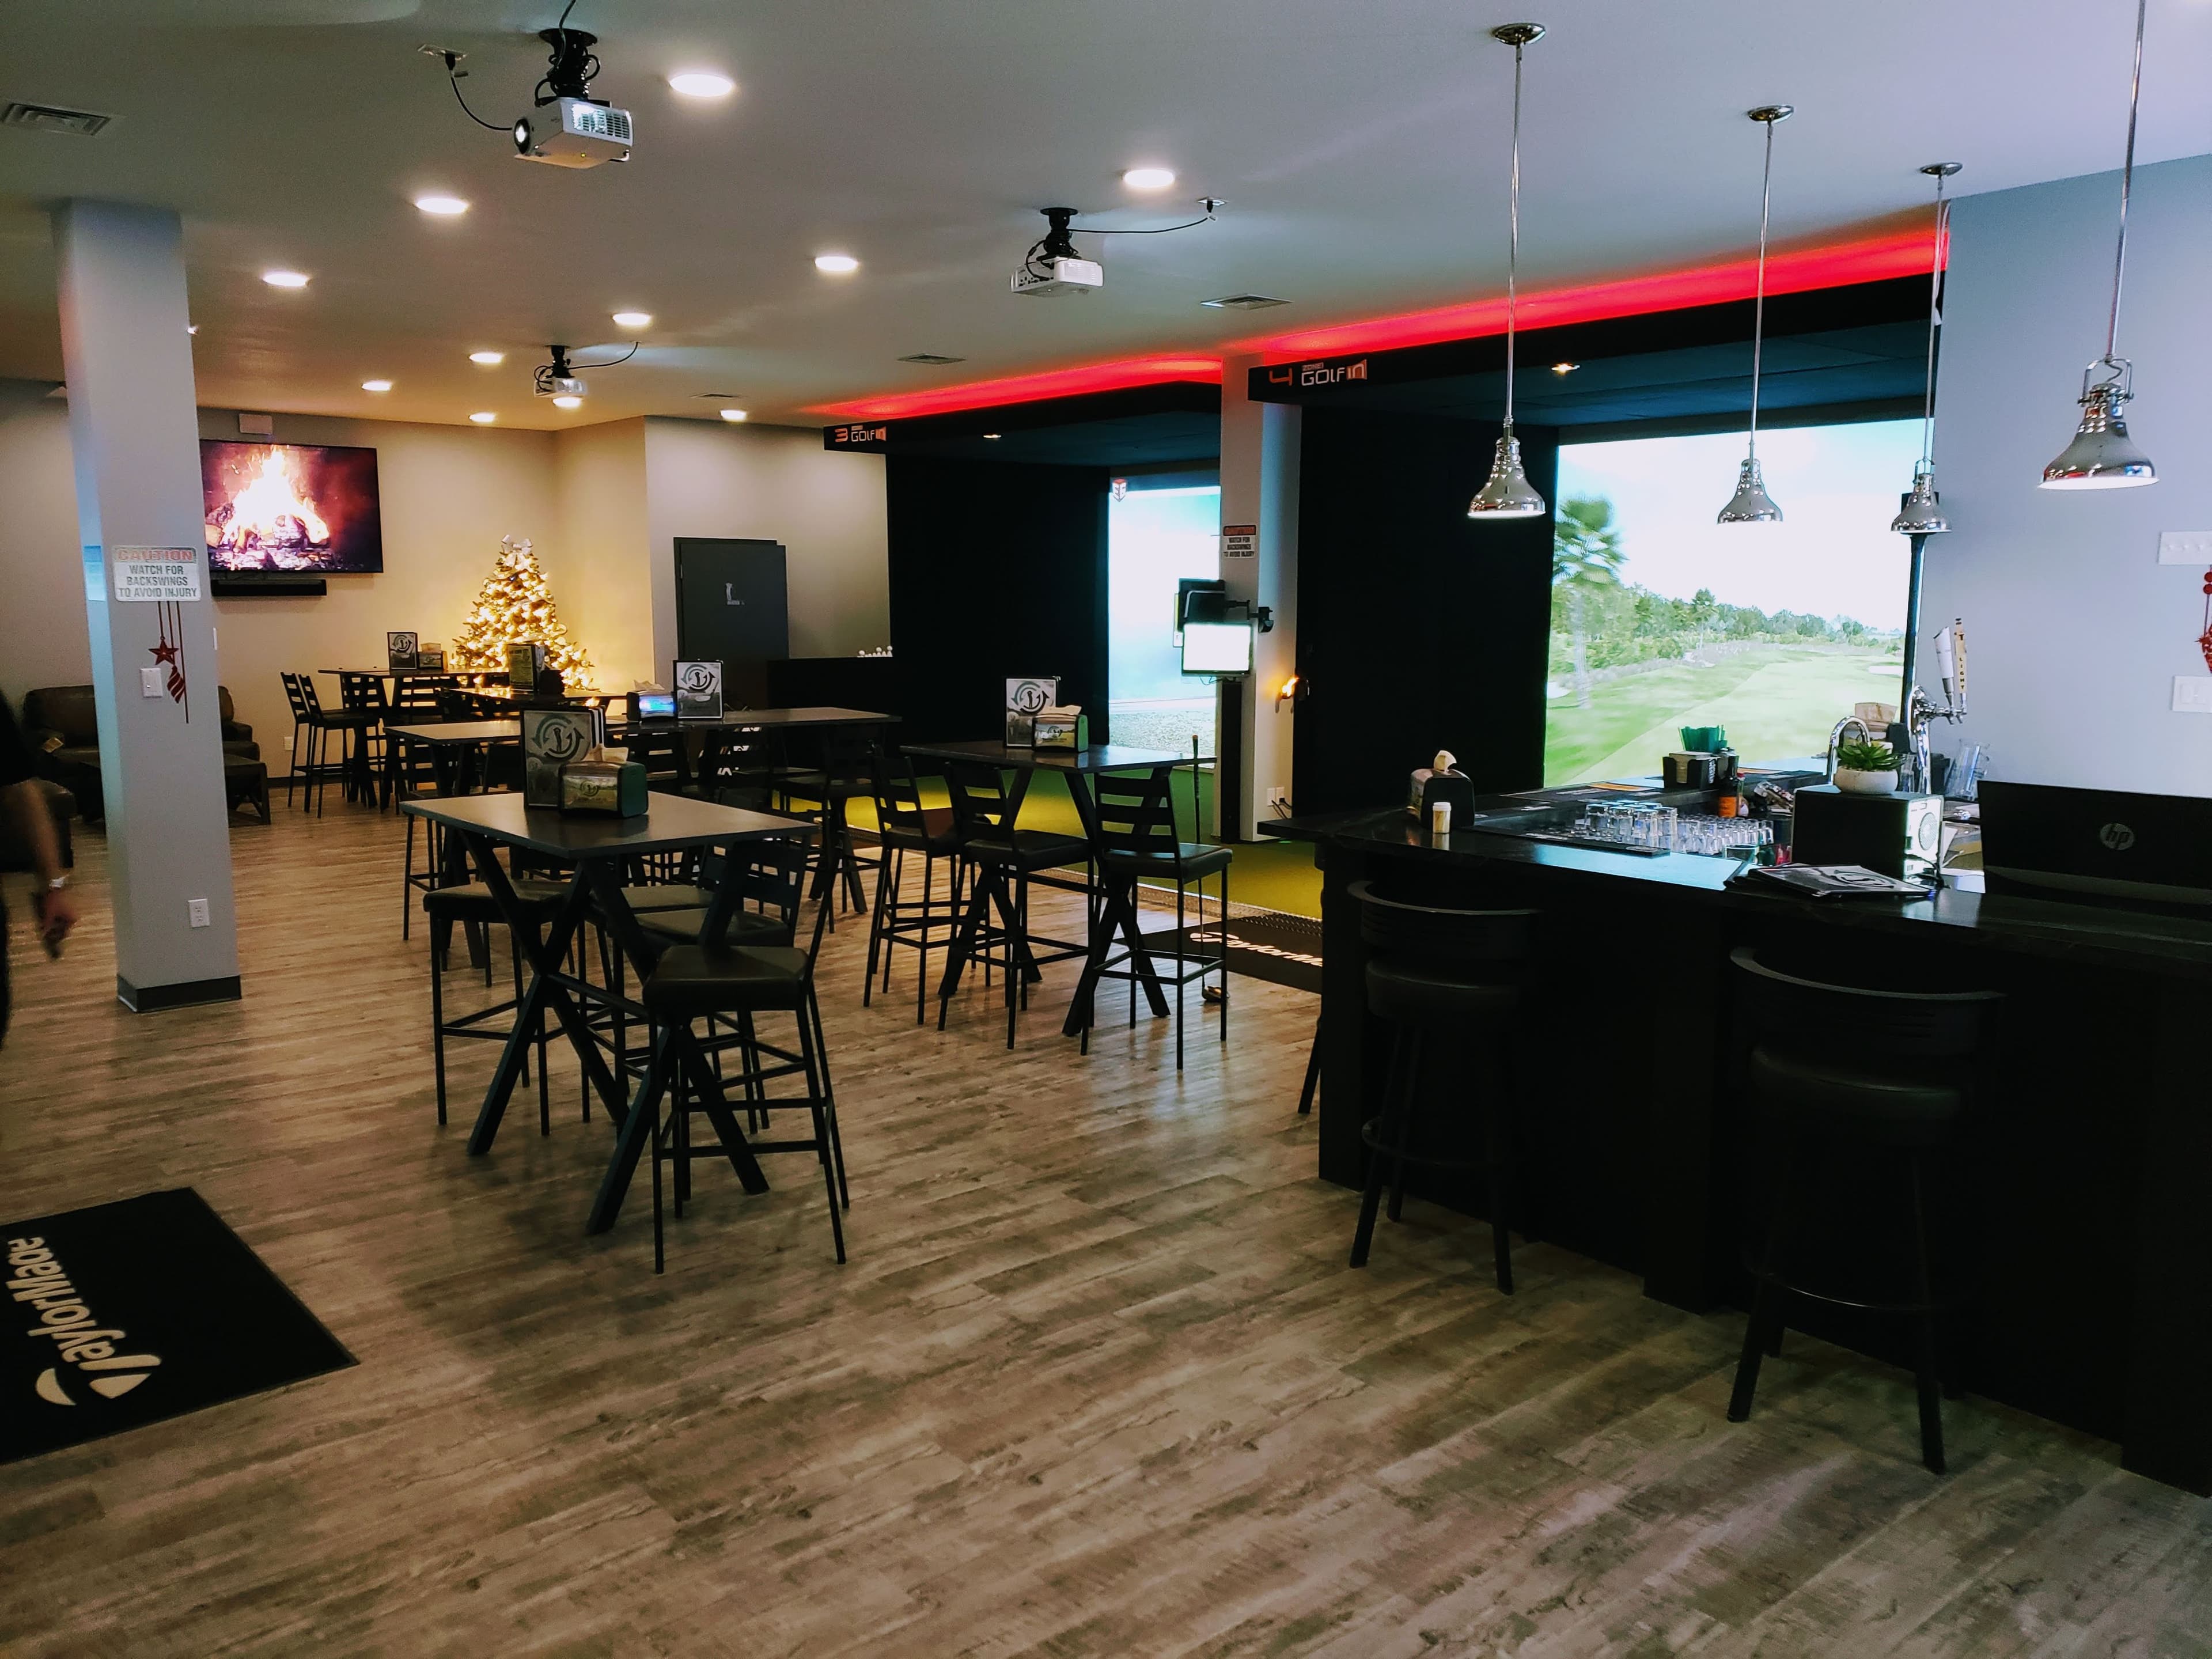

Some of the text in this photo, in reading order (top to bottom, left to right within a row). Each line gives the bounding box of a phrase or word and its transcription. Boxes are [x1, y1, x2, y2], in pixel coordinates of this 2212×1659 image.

[1269, 368, 1292, 386] 4
[835, 428, 848, 442] 3
[118, 549, 193, 561] CAUTION
[129, 565, 184, 575] WATCH FOR
[127, 576, 188, 586] BACKSWINGS
[119, 588, 197, 597] TO AVOID INJURY
[2105, 823, 2131, 850] hp
[5, 1237, 162, 1406] TaylorMade
